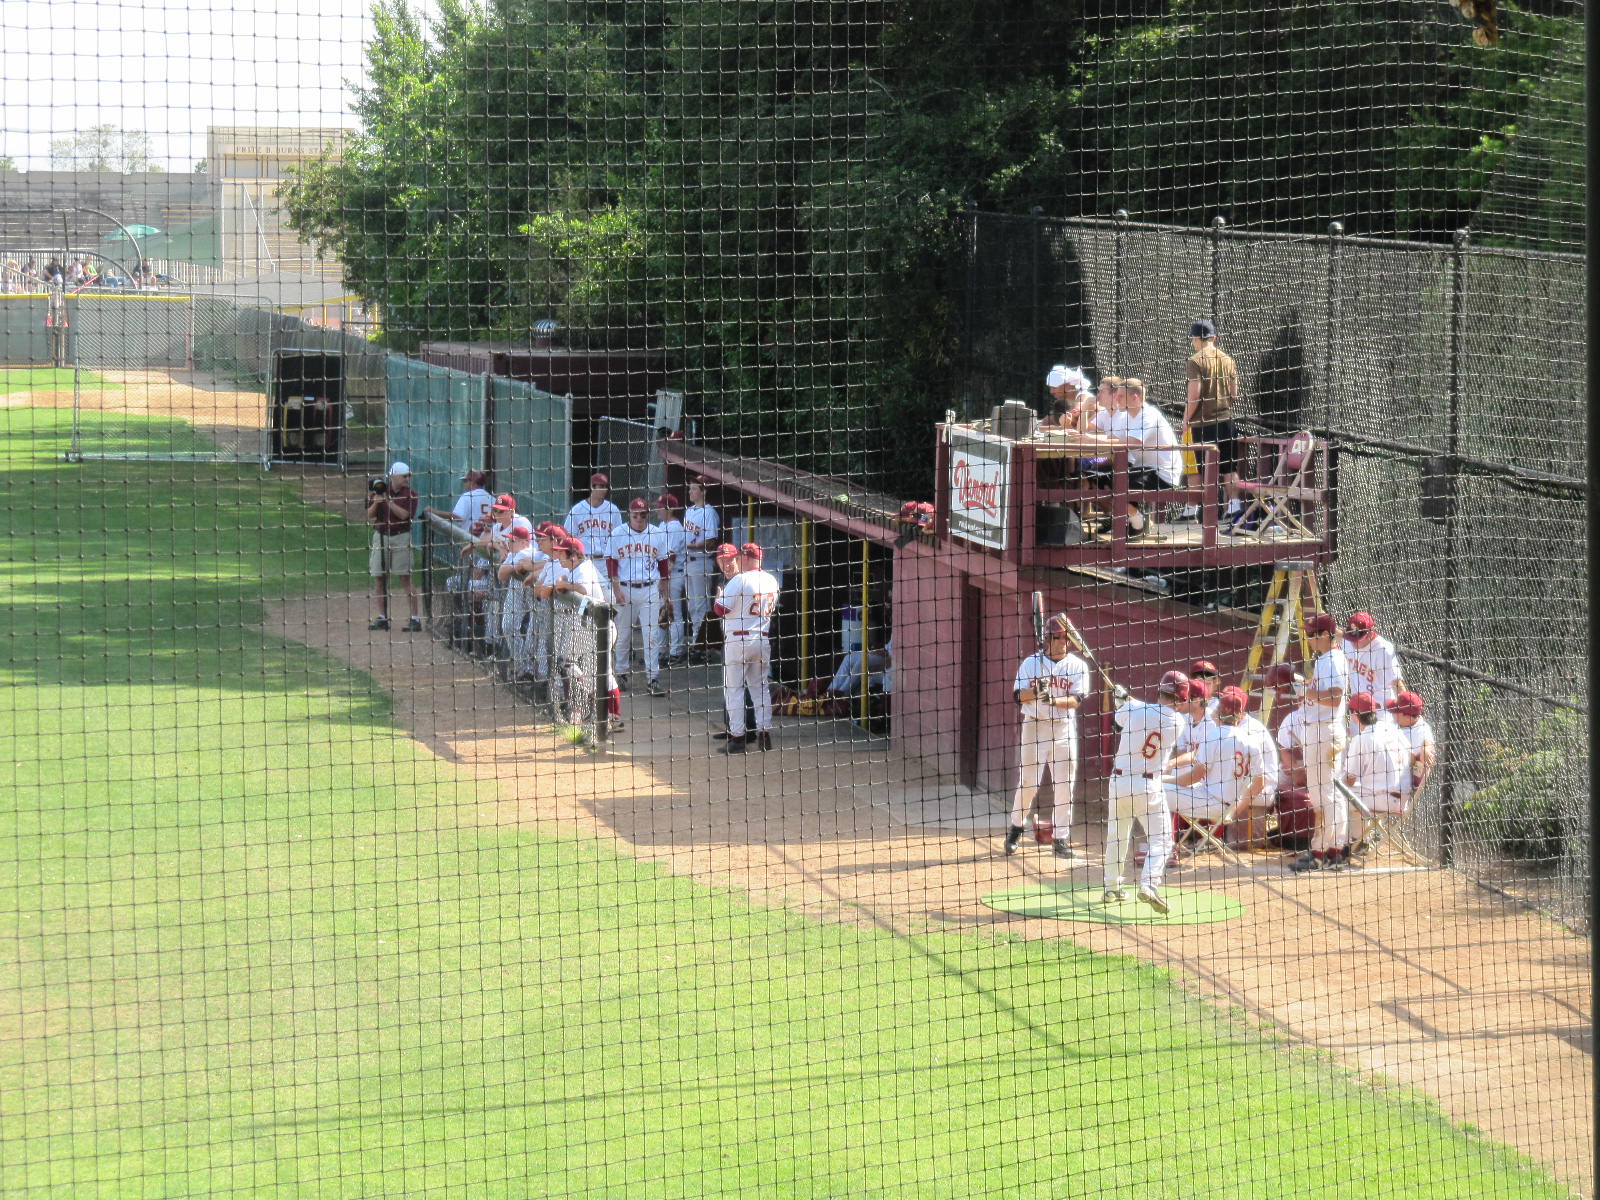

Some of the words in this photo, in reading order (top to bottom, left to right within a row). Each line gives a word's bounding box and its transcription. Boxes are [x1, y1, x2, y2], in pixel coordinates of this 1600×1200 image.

[578, 518, 613, 535] STAGS
[617, 542, 658, 559] STAGS
[1141, 731, 1162, 760] 6
